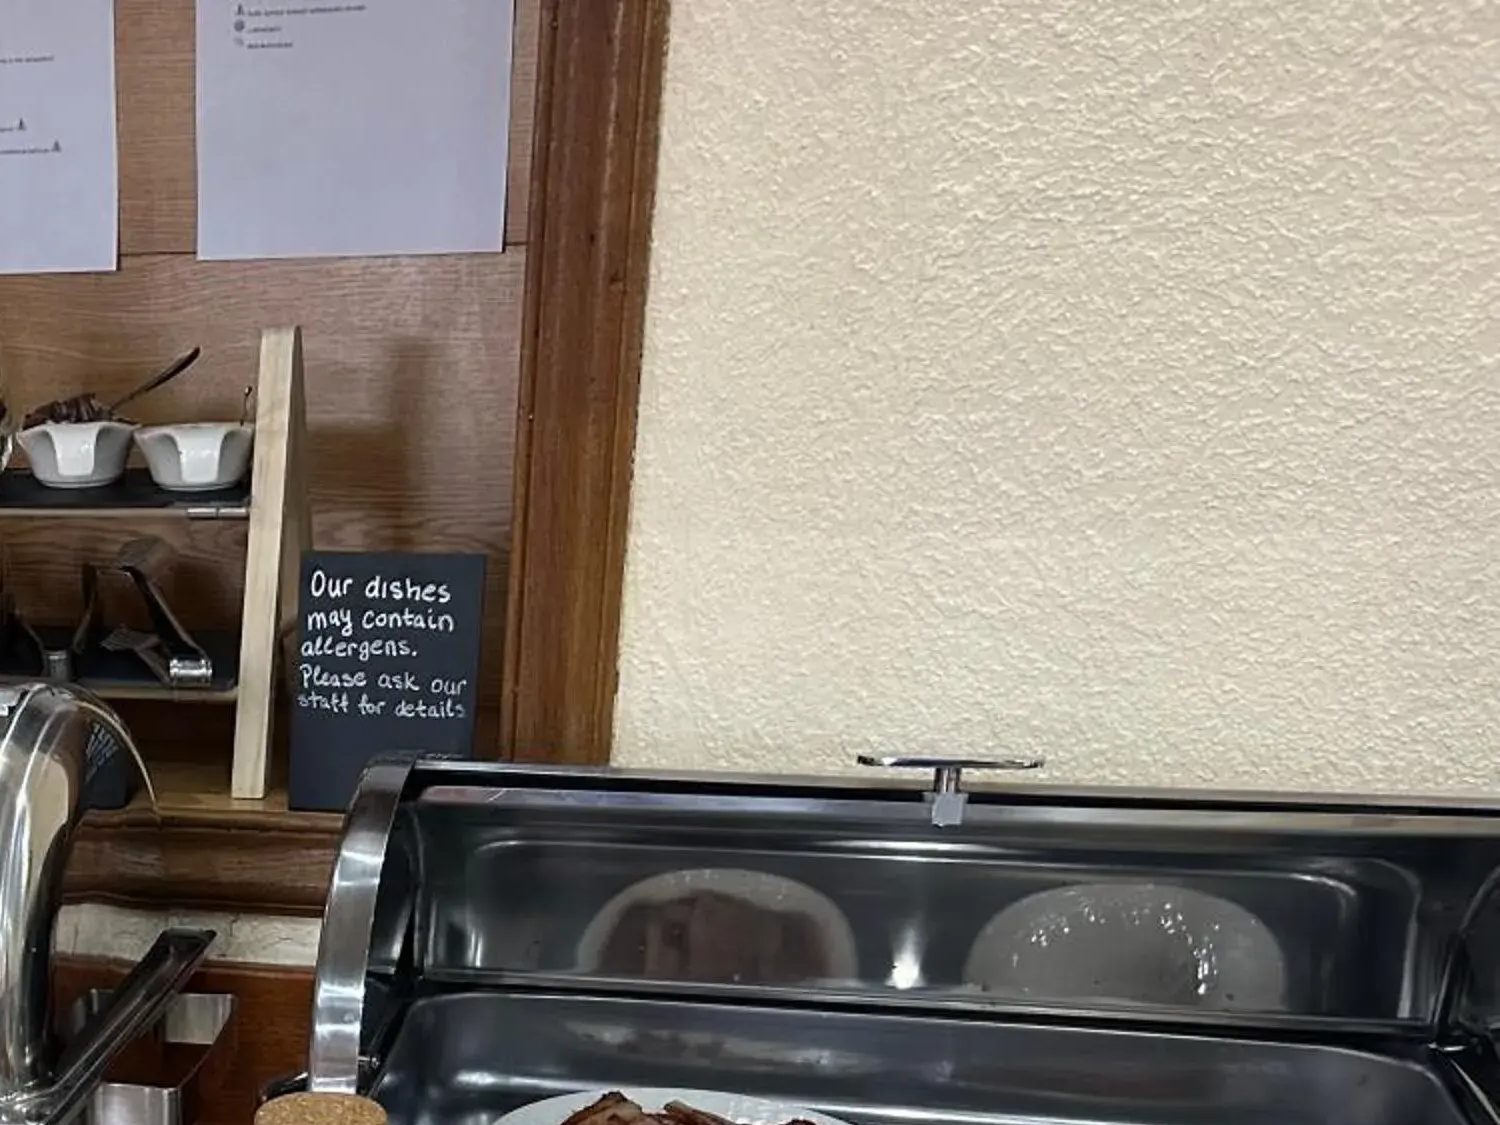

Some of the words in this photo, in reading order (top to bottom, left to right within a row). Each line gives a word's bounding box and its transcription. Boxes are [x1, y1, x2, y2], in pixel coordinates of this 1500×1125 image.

[310, 569, 353, 598] Our
[365, 575, 451, 603] dishes
[307, 607, 353, 636] may
[361, 607, 455, 632] contain
[301, 635, 418, 661] allergens.
[299, 663, 367, 688] Please
[377, 671, 420, 691] ask
[430, 678, 467, 695] our
[298, 691, 349, 713] staff
[358, 692, 386, 715] for
[394, 697, 467, 719] details
